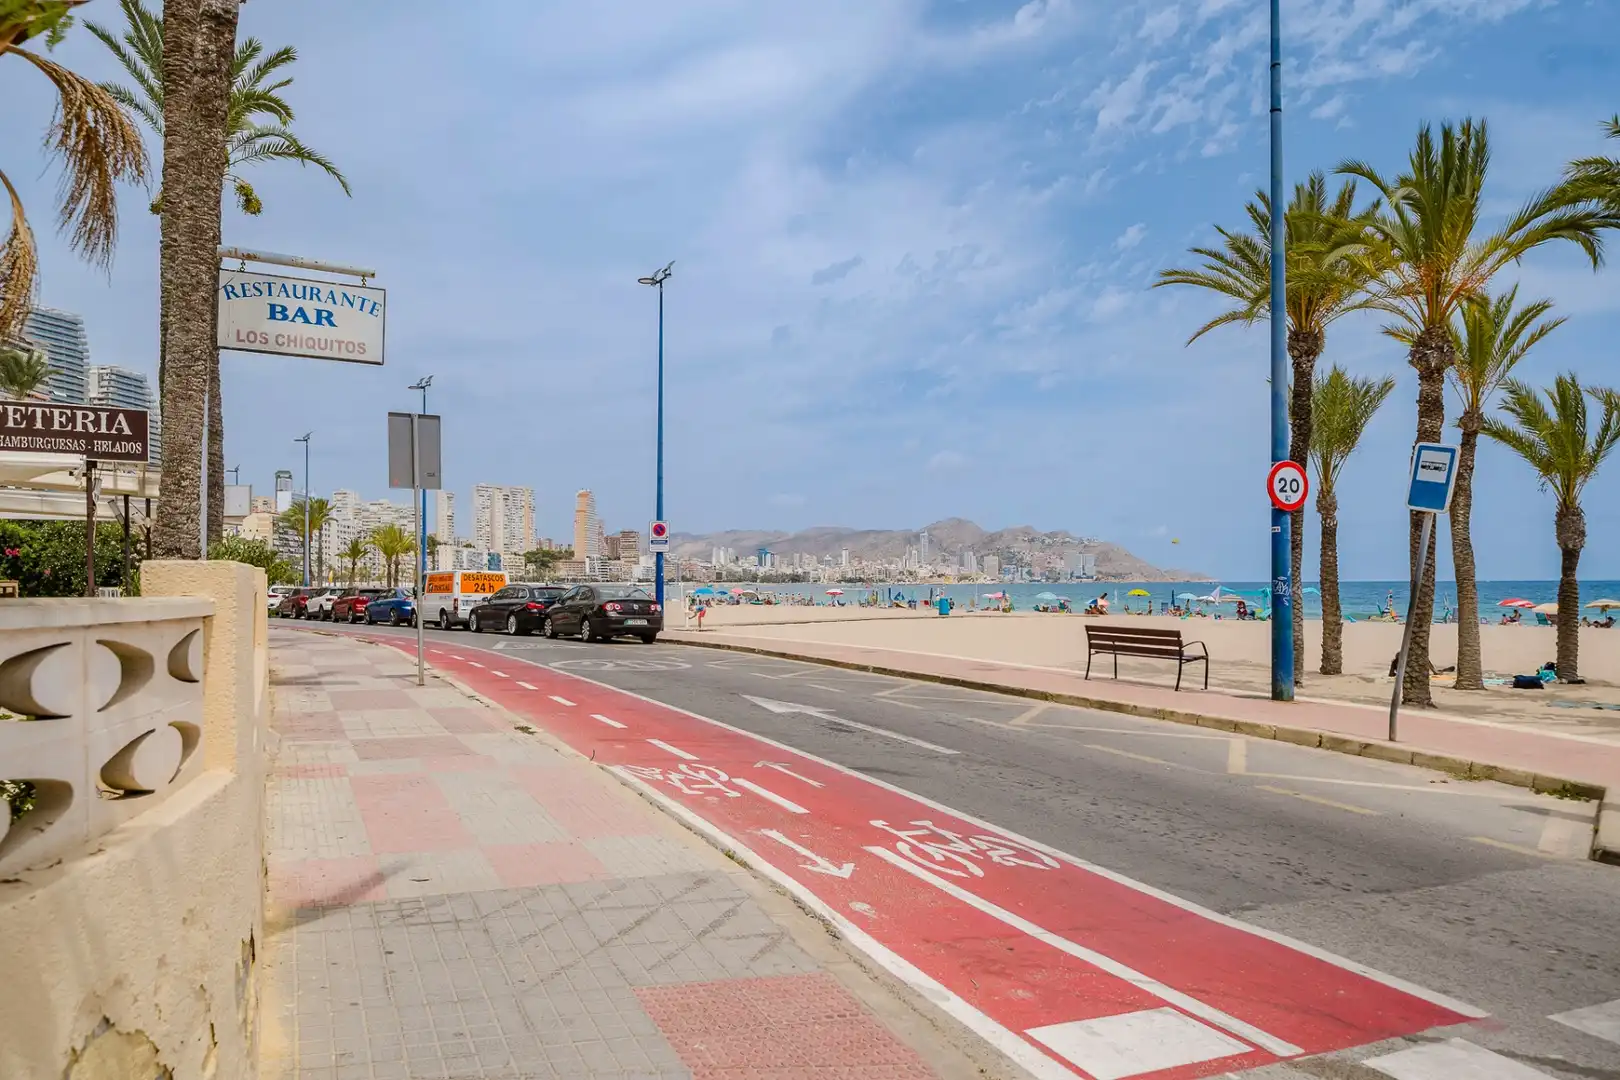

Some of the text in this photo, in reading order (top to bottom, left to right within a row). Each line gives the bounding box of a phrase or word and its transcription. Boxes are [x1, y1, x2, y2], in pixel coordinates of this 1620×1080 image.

[222, 281, 382, 318] RESTAURANTE
[266, 302, 338, 328] BAR
[236, 328, 367, 355] LOS CHIQUITOS
[0, 405, 132, 436] ETERIA
[93, 440, 142, 454] HELADOS
[1278, 477, 1300, 493] 20
[463, 573, 504, 582] DESATASCOS
[474, 583, 495, 593] 24 h
